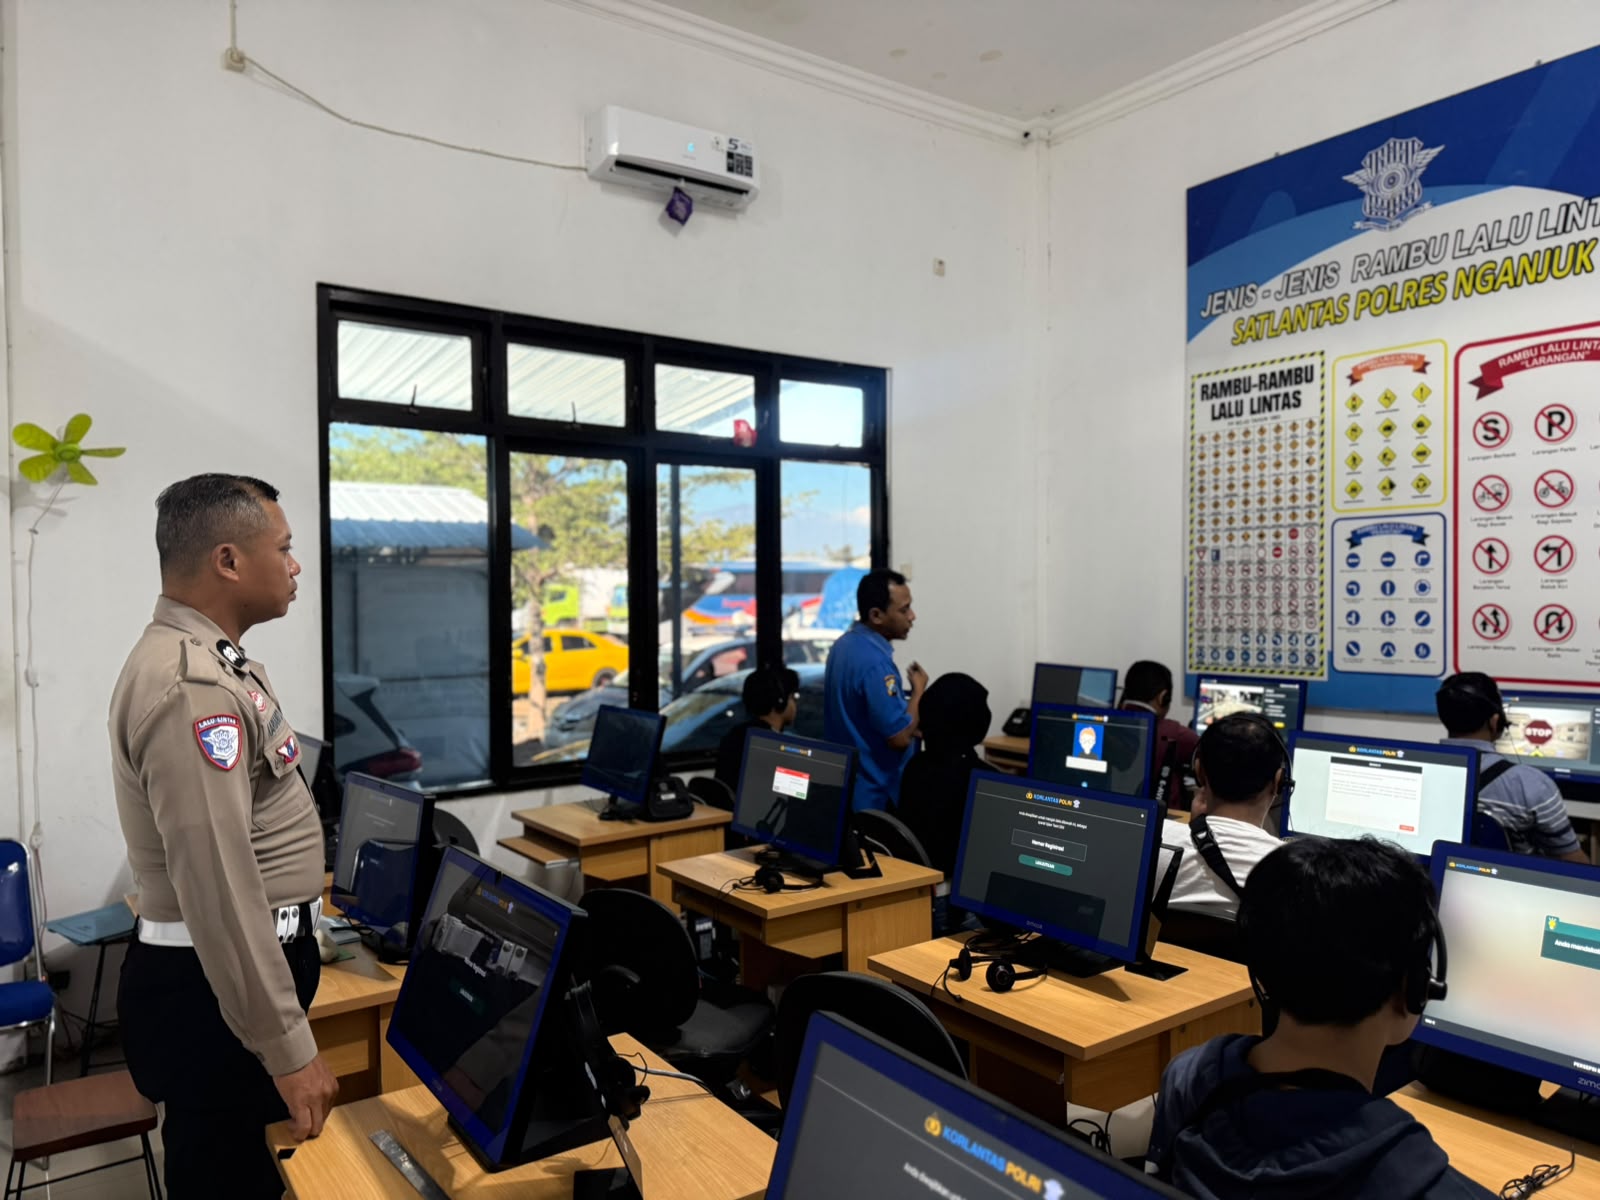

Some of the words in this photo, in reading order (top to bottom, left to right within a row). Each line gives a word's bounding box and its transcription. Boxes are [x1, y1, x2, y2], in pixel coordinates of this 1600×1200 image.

[1200, 283, 1260, 319] JENIS
[1274, 260, 1341, 301] JENIS
[1351, 233, 1449, 283] RAMBU
[1452, 212, 1533, 259] LALU
[1231, 292, 1351, 346] SATLANTAS
[1353, 270, 1448, 320] POLRES
[1452, 237, 1598, 300] NGANJUK
[1498, 347, 1538, 368] RAMBU
[1540, 342, 1570, 355] LALU
[1201, 364, 1315, 401] RAMBU-RAMBU
[1210, 399, 1244, 421] LALU
[1249, 390, 1302, 415] LINTAS
[1525, 727, 1552, 738] STOP
[942, 1125, 1006, 1173] KORLANTAS
[1005, 1161, 1043, 1194] POLRI
